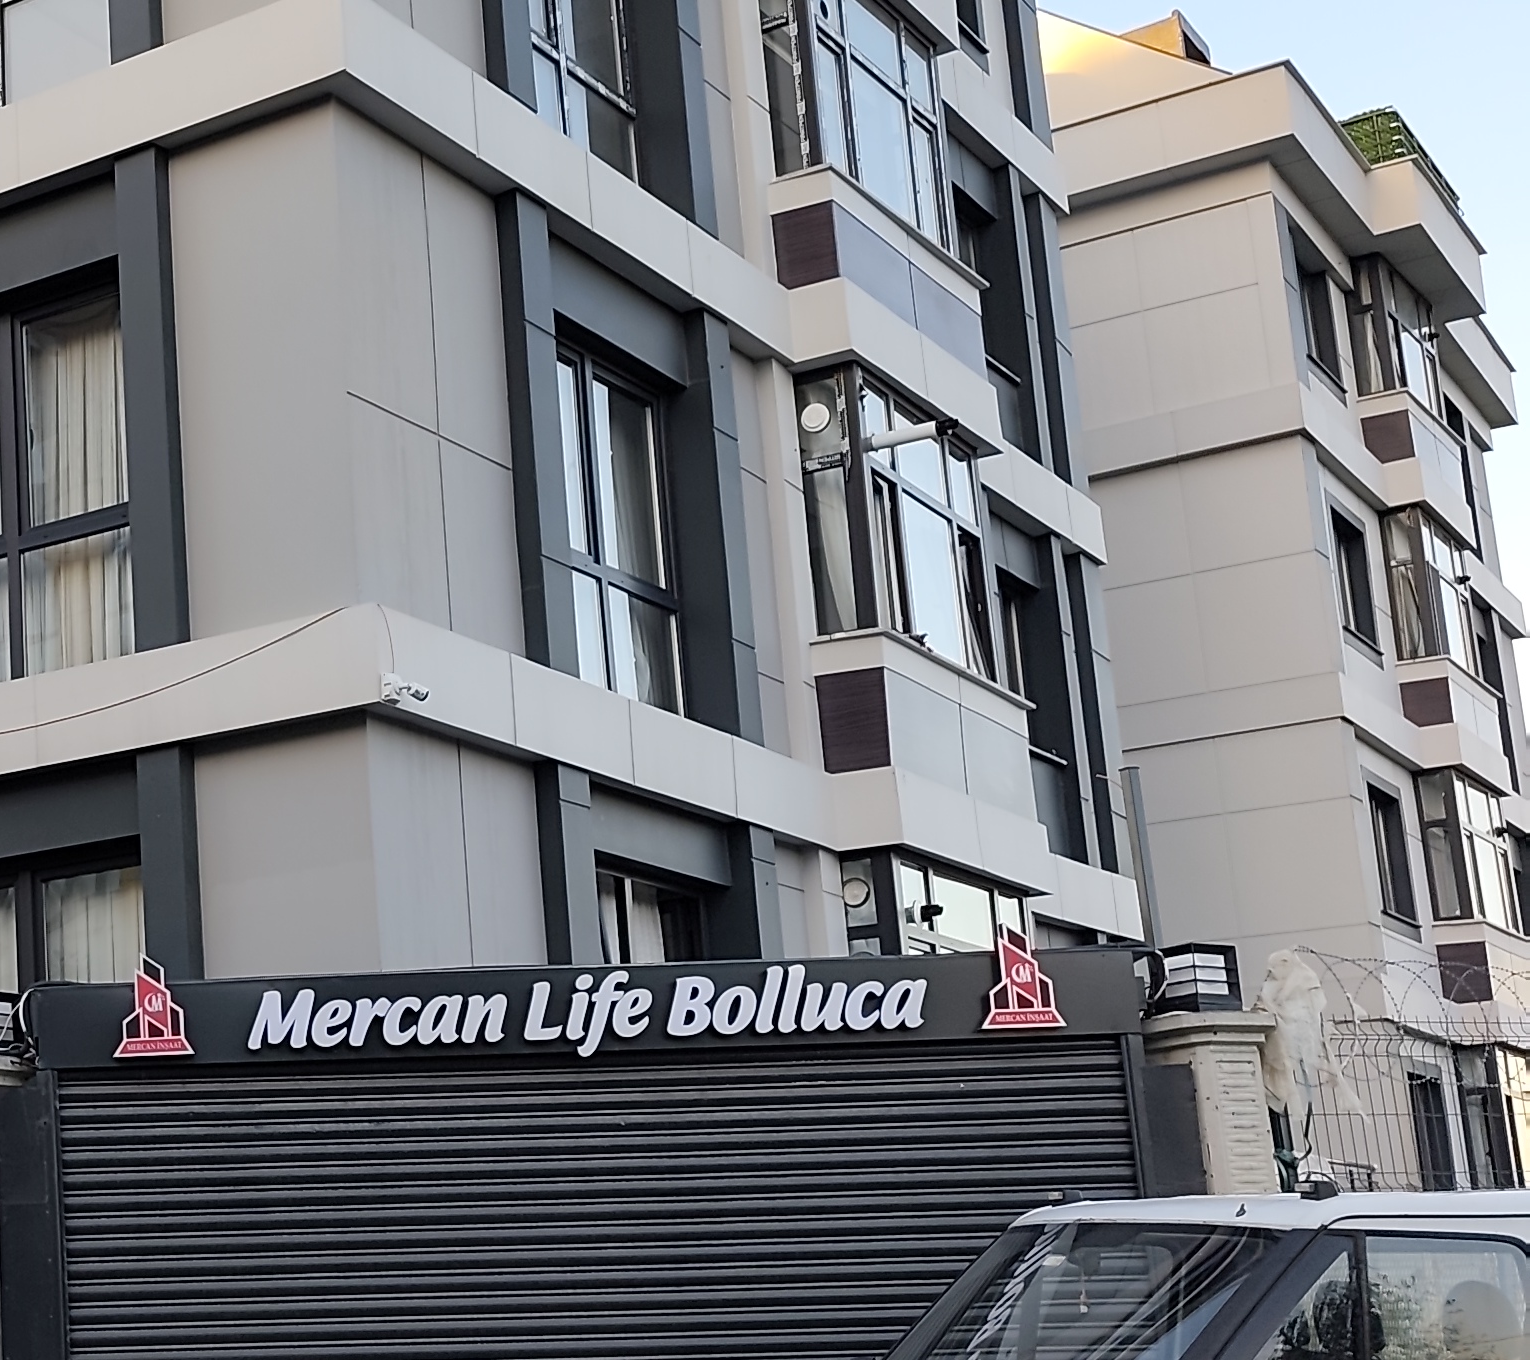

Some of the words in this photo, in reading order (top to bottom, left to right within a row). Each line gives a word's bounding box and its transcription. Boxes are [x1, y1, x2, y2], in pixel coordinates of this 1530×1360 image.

[247, 989, 507, 1050] Mercan
[524, 971, 653, 1057] Life
[666, 964, 928, 1035] Bolluca
[995, 1013, 1026, 1022] MERCAN
[126, 1042, 156, 1051] MERCAN
